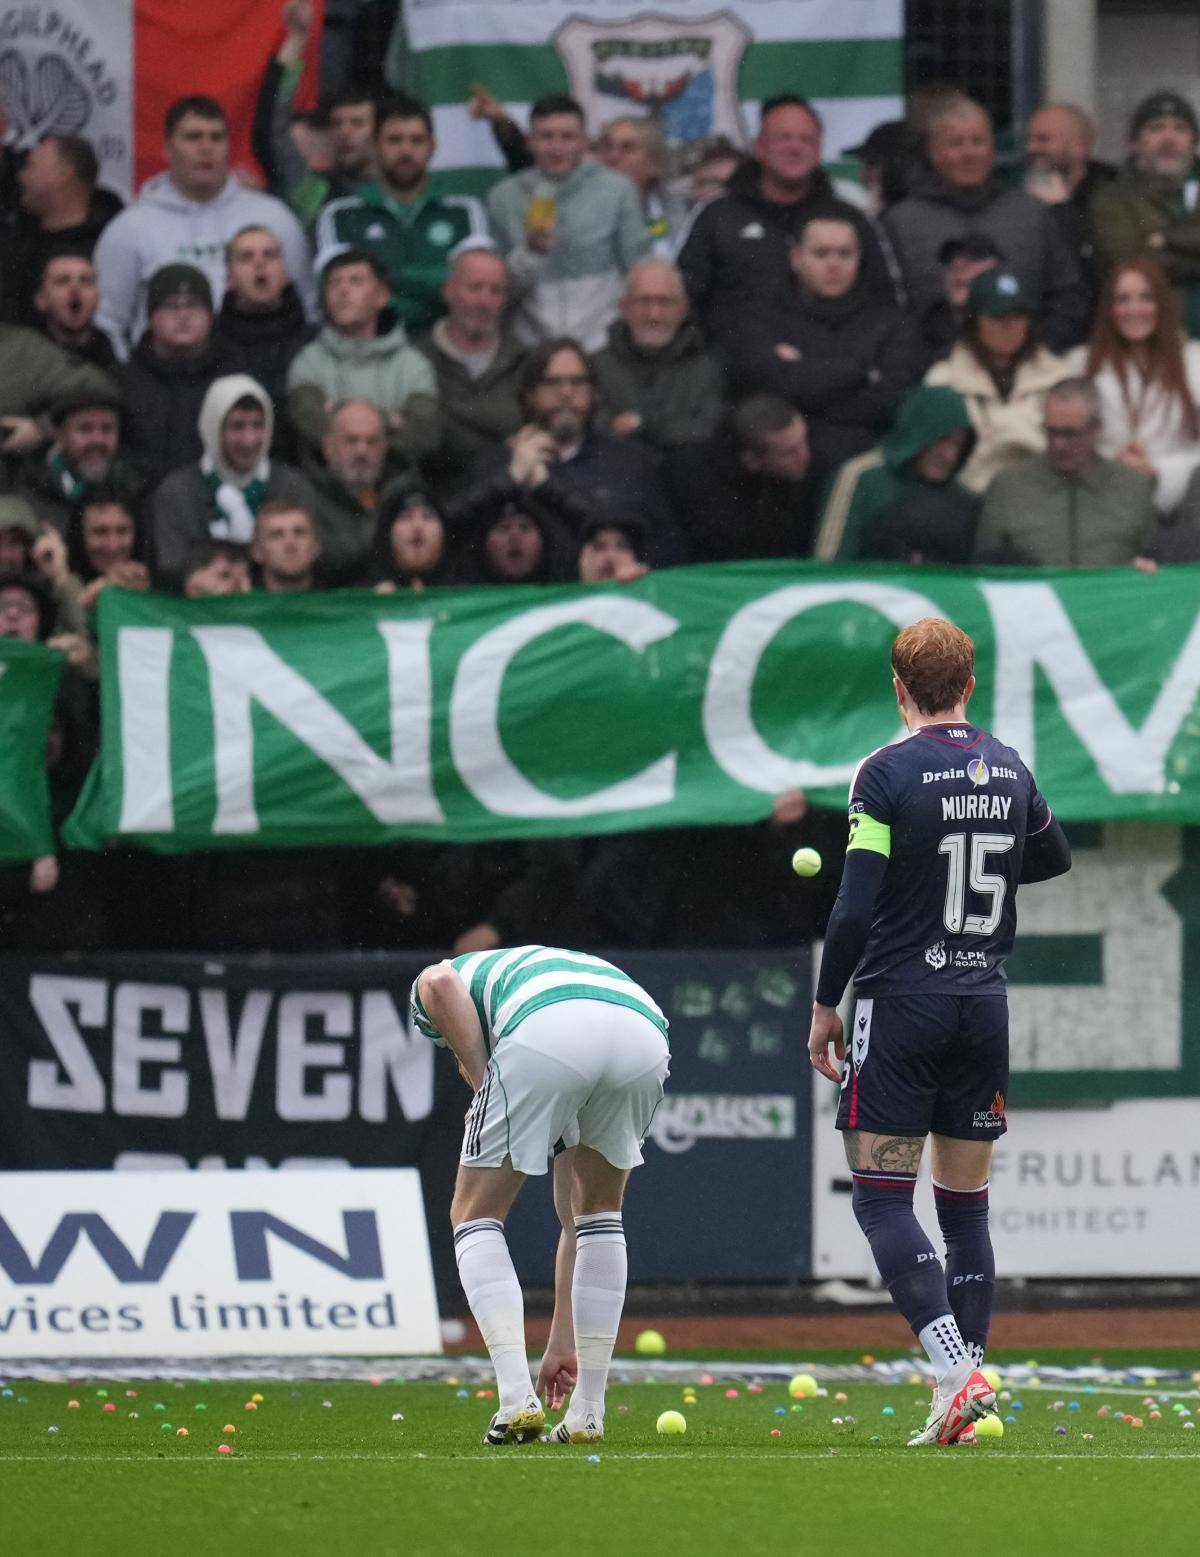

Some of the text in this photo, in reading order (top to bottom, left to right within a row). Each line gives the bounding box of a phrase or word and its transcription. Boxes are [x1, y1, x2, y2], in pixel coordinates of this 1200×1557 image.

[922, 766, 1018, 784] Drain Blitz
[941, 794, 1012, 821] MURRAY
[938, 832, 1016, 936] 15
[27, 973, 435, 1123] SEVEN
[989, 1207, 1151, 1234] CHITECT
[952, 1273, 985, 1287] DFC
[170, 1292, 398, 1331] limited
